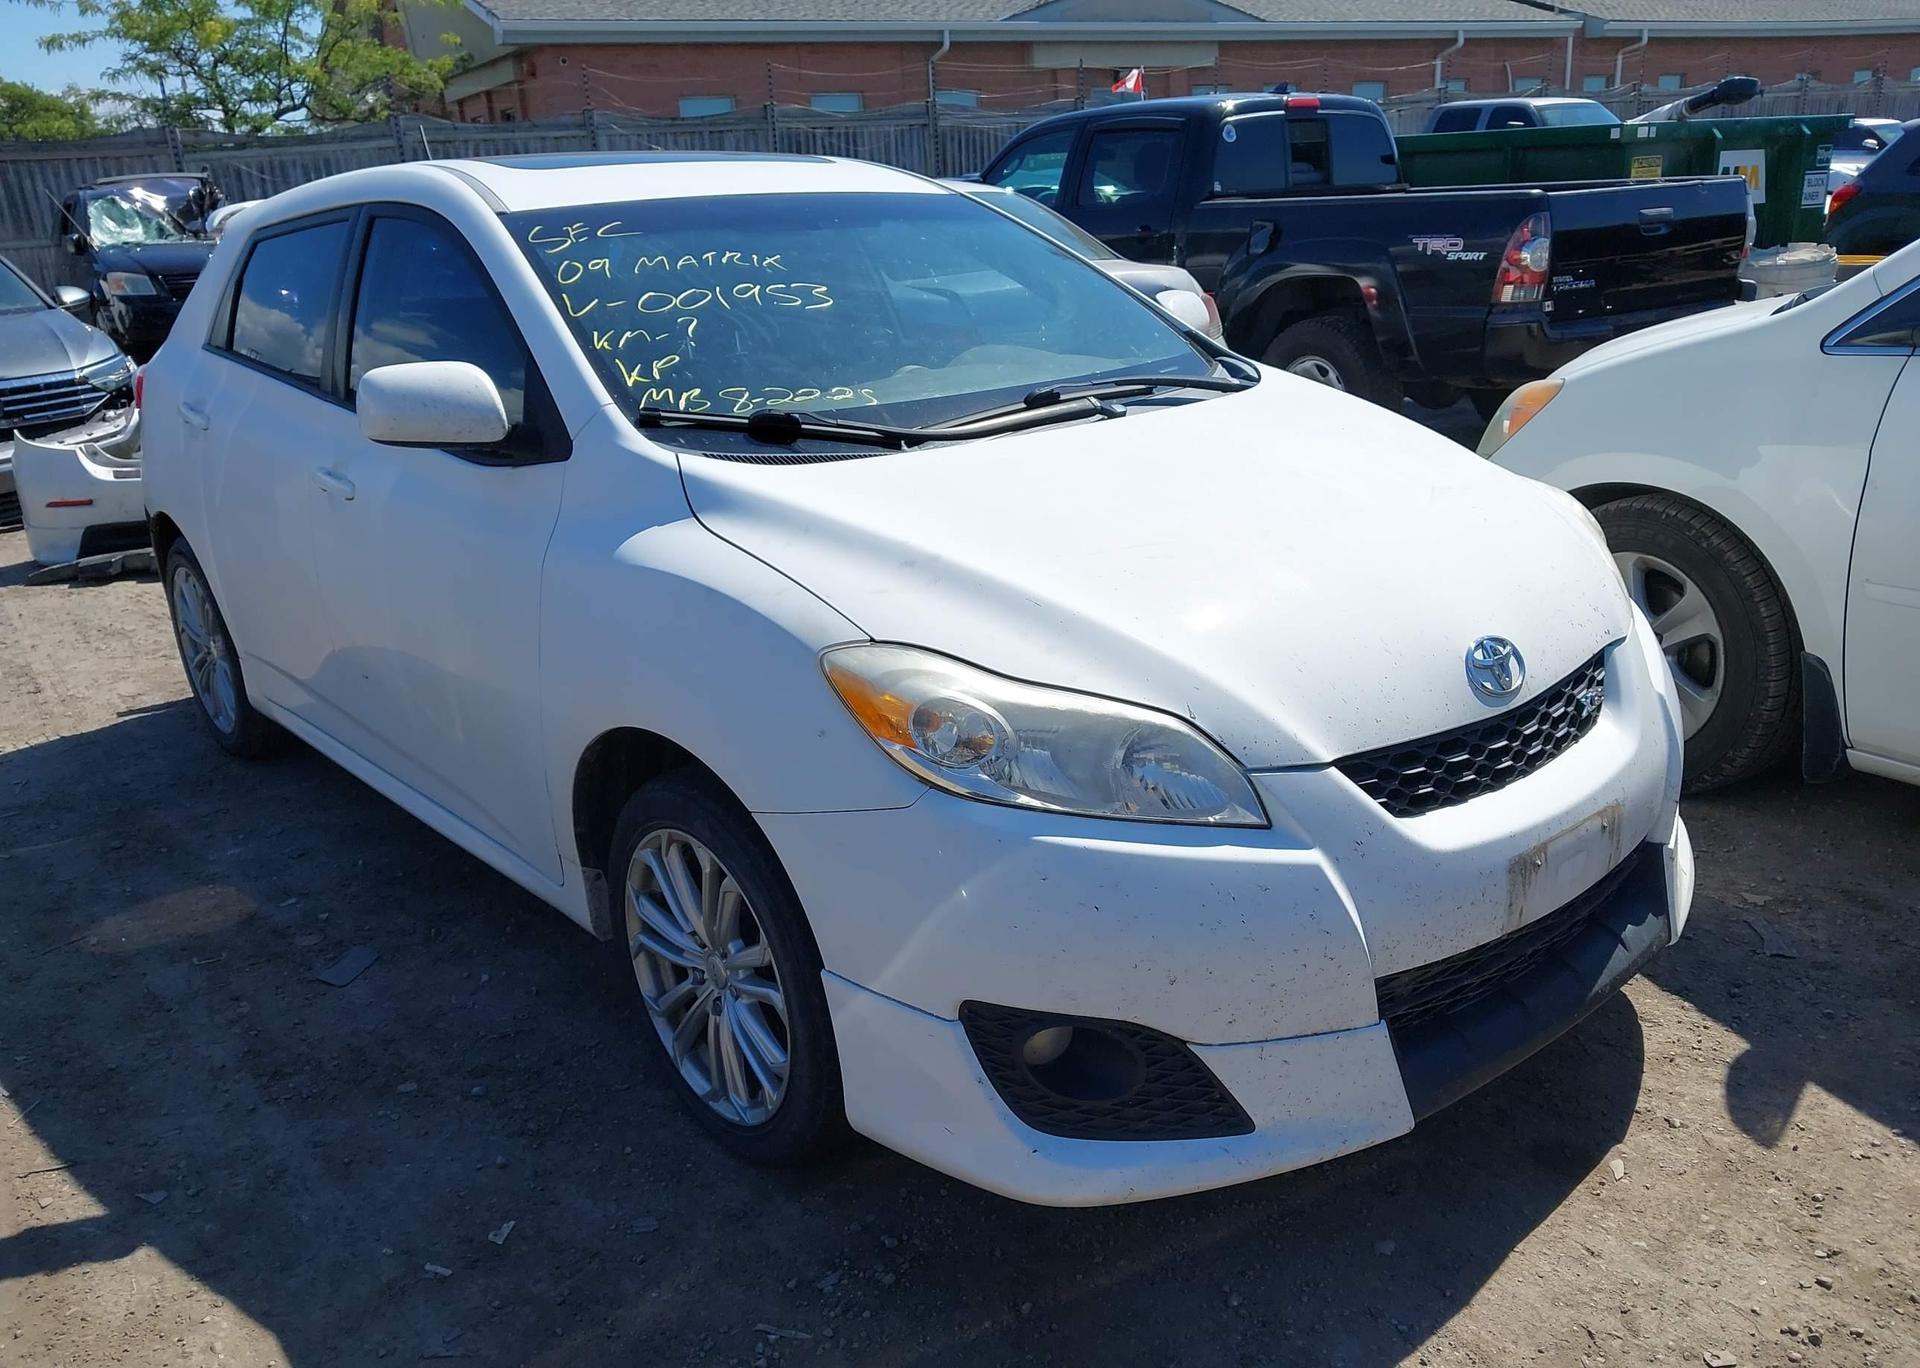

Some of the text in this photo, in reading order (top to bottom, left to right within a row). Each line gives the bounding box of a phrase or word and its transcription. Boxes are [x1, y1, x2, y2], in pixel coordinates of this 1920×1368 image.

[527, 221, 643, 253] SEC
[1412, 238, 1463, 255] TRD
[557, 251, 788, 284] 09 MATRIX
[1446, 252, 1488, 260] SPORT
[640, 387, 711, 411] MB
